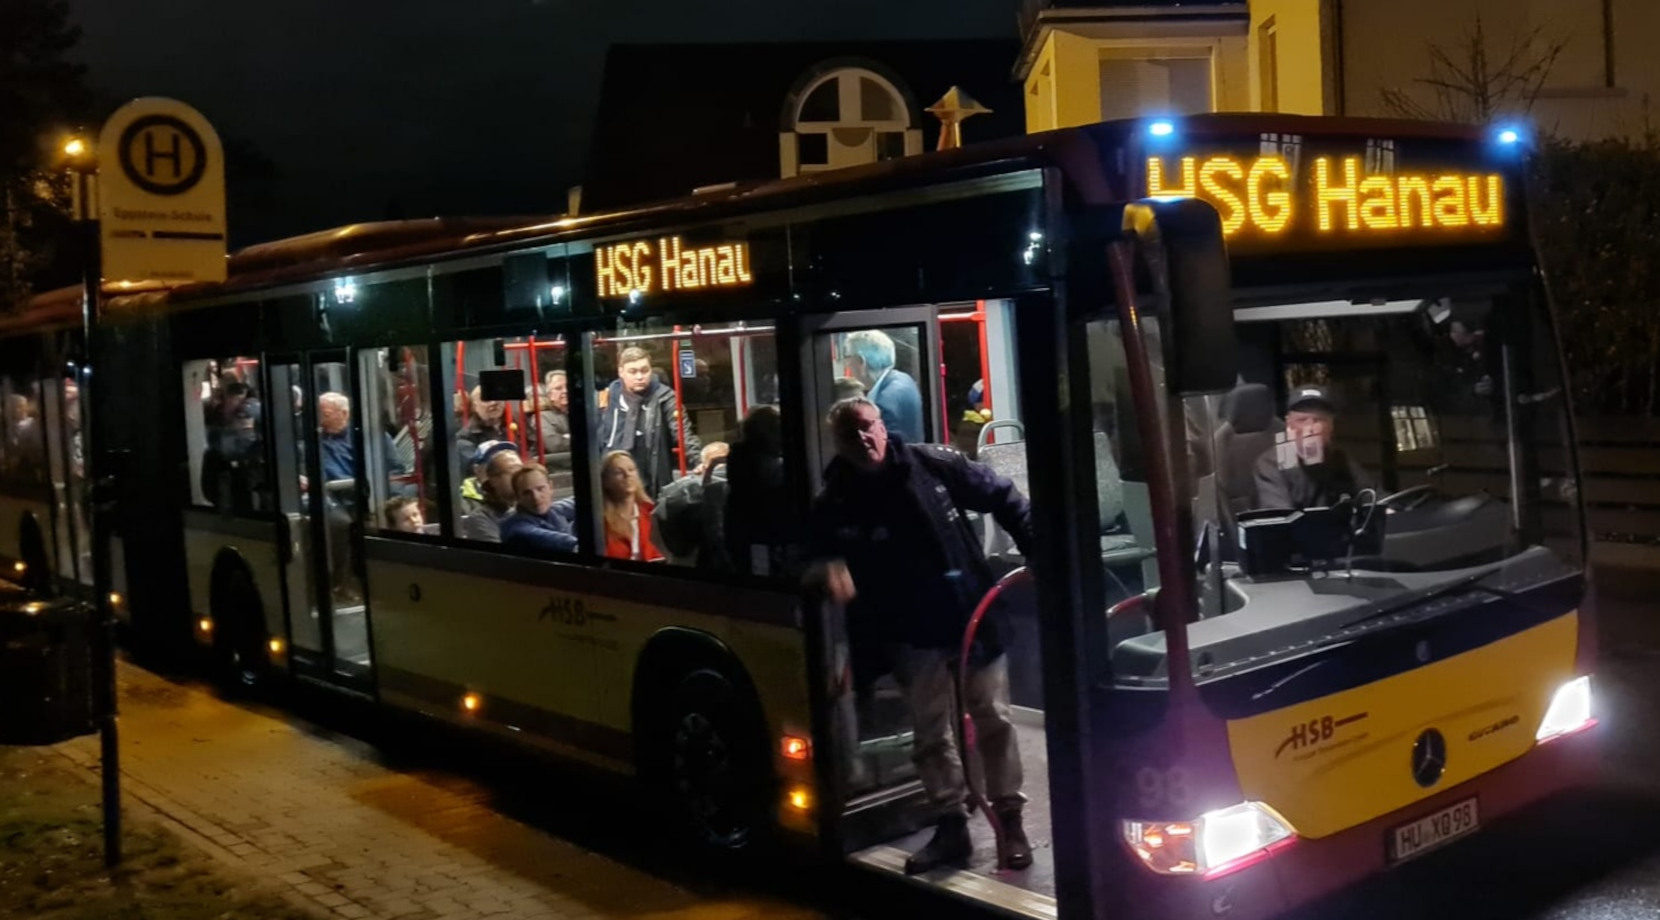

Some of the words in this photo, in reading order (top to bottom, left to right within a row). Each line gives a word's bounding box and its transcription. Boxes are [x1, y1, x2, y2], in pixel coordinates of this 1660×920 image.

[144, 130, 181, 178] H
[1315, 156, 1503, 232] Hanau
[595, 241, 652, 297] HSG
[548, 596, 586, 626] HSB
[1291, 714, 1334, 750] HSB
[1400, 823, 1422, 854] HU
[1453, 803, 1472, 832] 98
